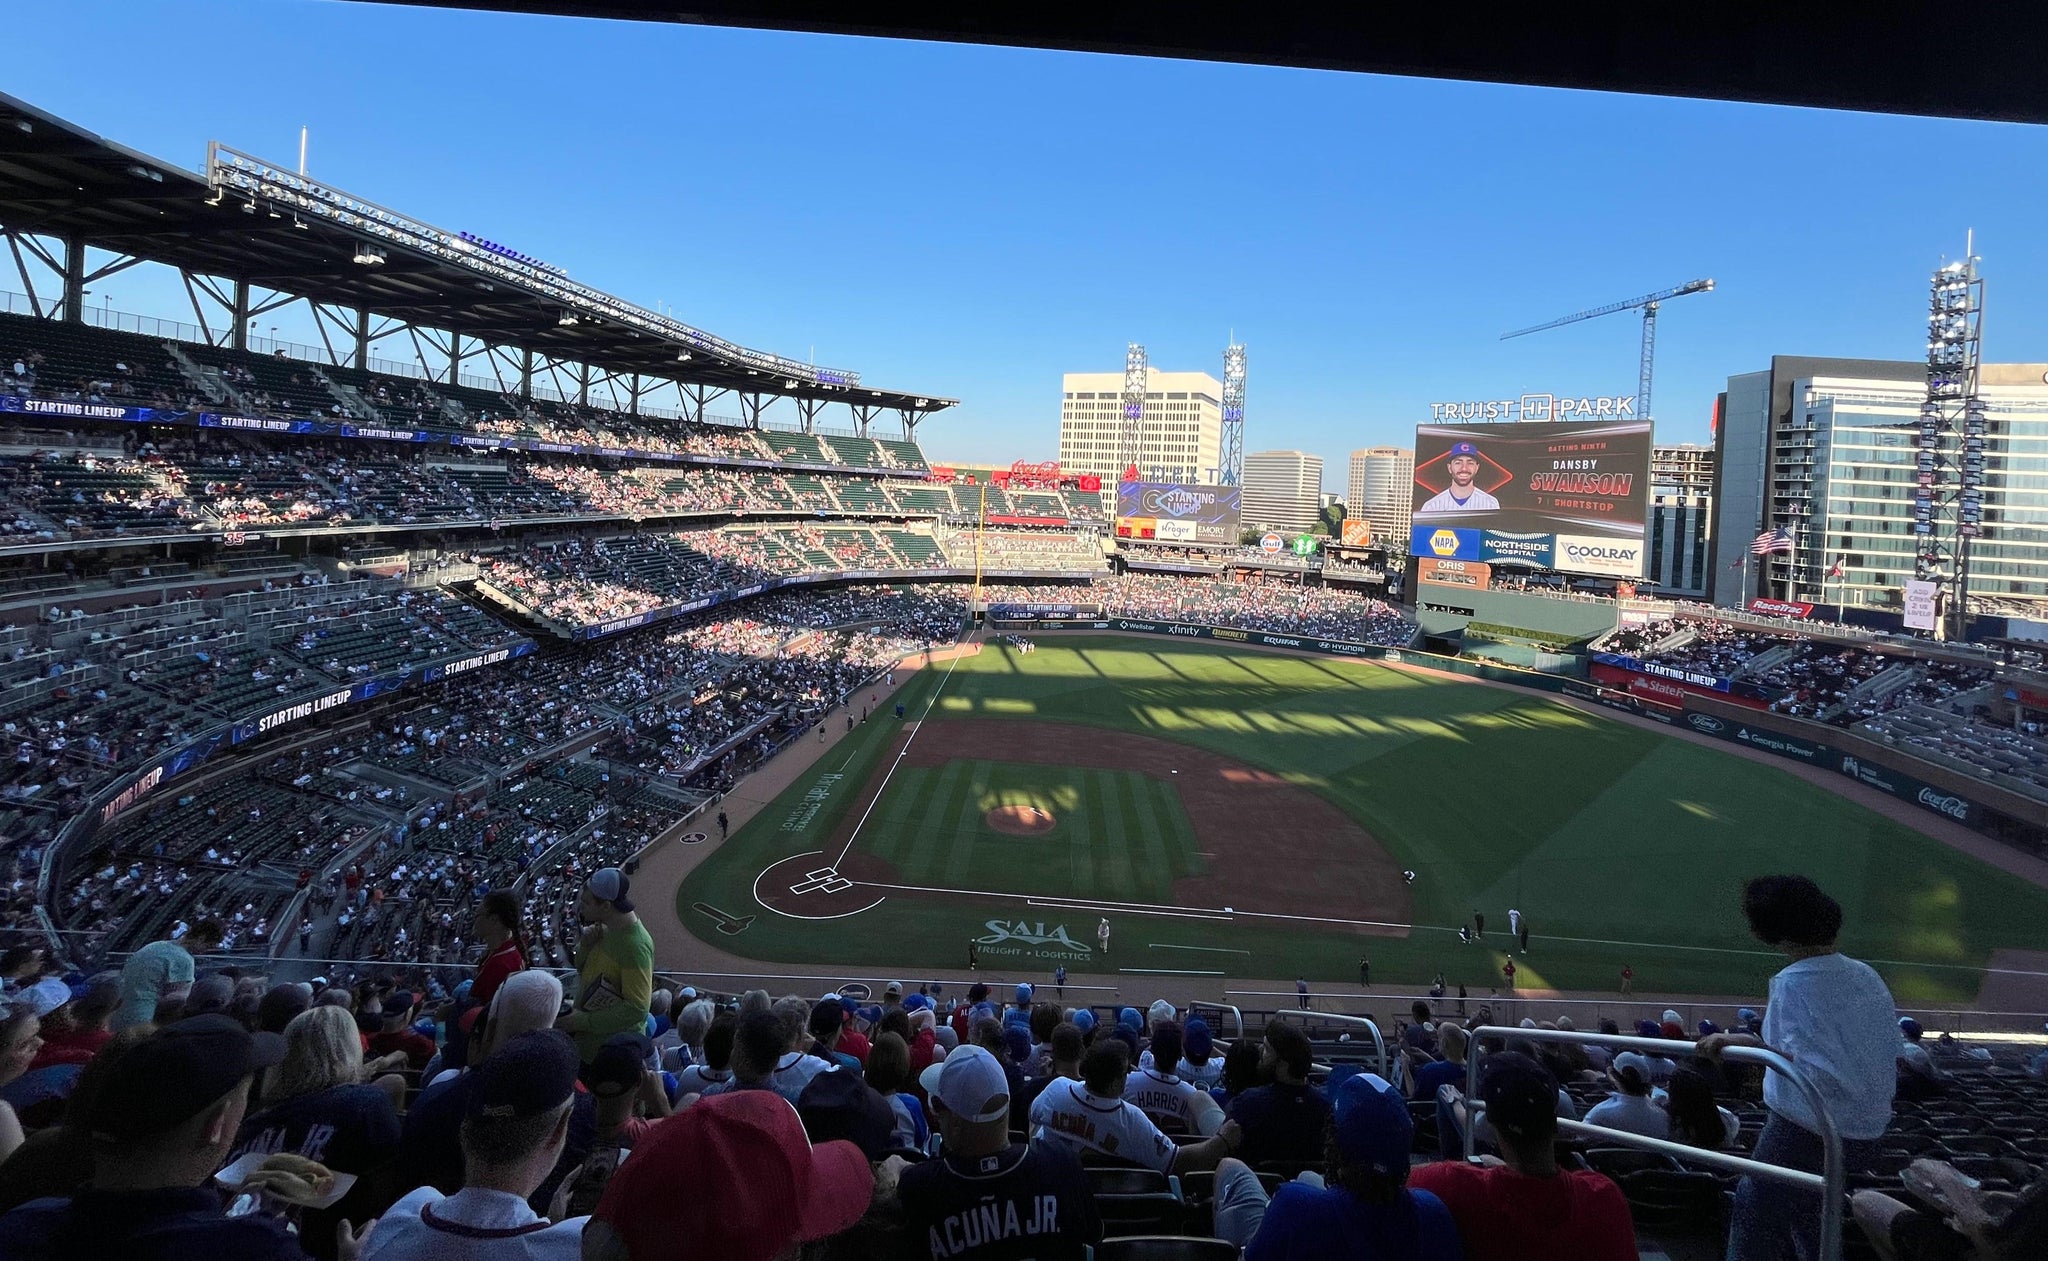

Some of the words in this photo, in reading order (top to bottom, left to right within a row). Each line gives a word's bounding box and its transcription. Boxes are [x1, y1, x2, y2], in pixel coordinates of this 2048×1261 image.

[25, 400, 83, 415] STARTING
[84, 406, 126, 418] LINEUP
[1430, 401, 1515, 419] TRUIST
[1559, 396, 1636, 417] PARK
[221, 416, 263, 429] STARTING
[264, 420, 290, 431] LINEUP
[358, 428, 390, 438] STARTING
[391, 430, 414, 440] LINEUP
[1553, 459, 1598, 470] DANSBY
[1530, 472, 1633, 496] SWANSON
[1167, 492, 1215, 504] STARTING
[1554, 498, 1614, 511] SHORTSTOP
[1167, 502, 1202, 514] LINEUP
[1162, 521, 1190, 537] Kroger
[1198, 526, 1226, 534] EMORY
[224, 532, 245, 546] 35
[1262, 539, 1281, 547] Gulf
[1434, 537, 1455, 549] NAPA
[1485, 540, 1550, 552] NORTHSIDE
[1496, 548, 1537, 557] HOSPITAL
[1567, 545, 1638, 560] COOLRAY
[1437, 560, 1466, 571] ORIS
[1753, 600, 1803, 614] RaceTrac
[600, 619, 626, 634] STARTING
[626, 615, 644, 627] LINEUP
[1129, 622, 1155, 631] Wellstar
[1168, 624, 1200, 637] xfinity
[1212, 628, 1249, 639] QUIKRETE
[1263, 636, 1300, 647] EQUIFAX
[1332, 643, 1366, 653] HYUNDAI
[445, 656, 482, 675] STARTING
[484, 649, 509, 665] LINEUP
[1644, 663, 1684, 680] STARTING
[1685, 672, 1717, 687] LINEUP
[259, 702, 312, 732] STARTING
[314, 689, 352, 713] LINEUP
[1693, 714, 1718, 729] Ford
[1751, 734, 1784, 750] Georgia
[1786, 743, 1814, 757] Power
[977, 919, 1092, 952] SAIA
[977, 945, 1021, 956] FREIGHT
[1035, 950, 1091, 961] LOGISTICS
[1137, 1091, 1179, 1112] HARRIS
[928, 1194, 1022, 1261] ACUÑA
[1026, 1194, 1061, 1235] JR.
